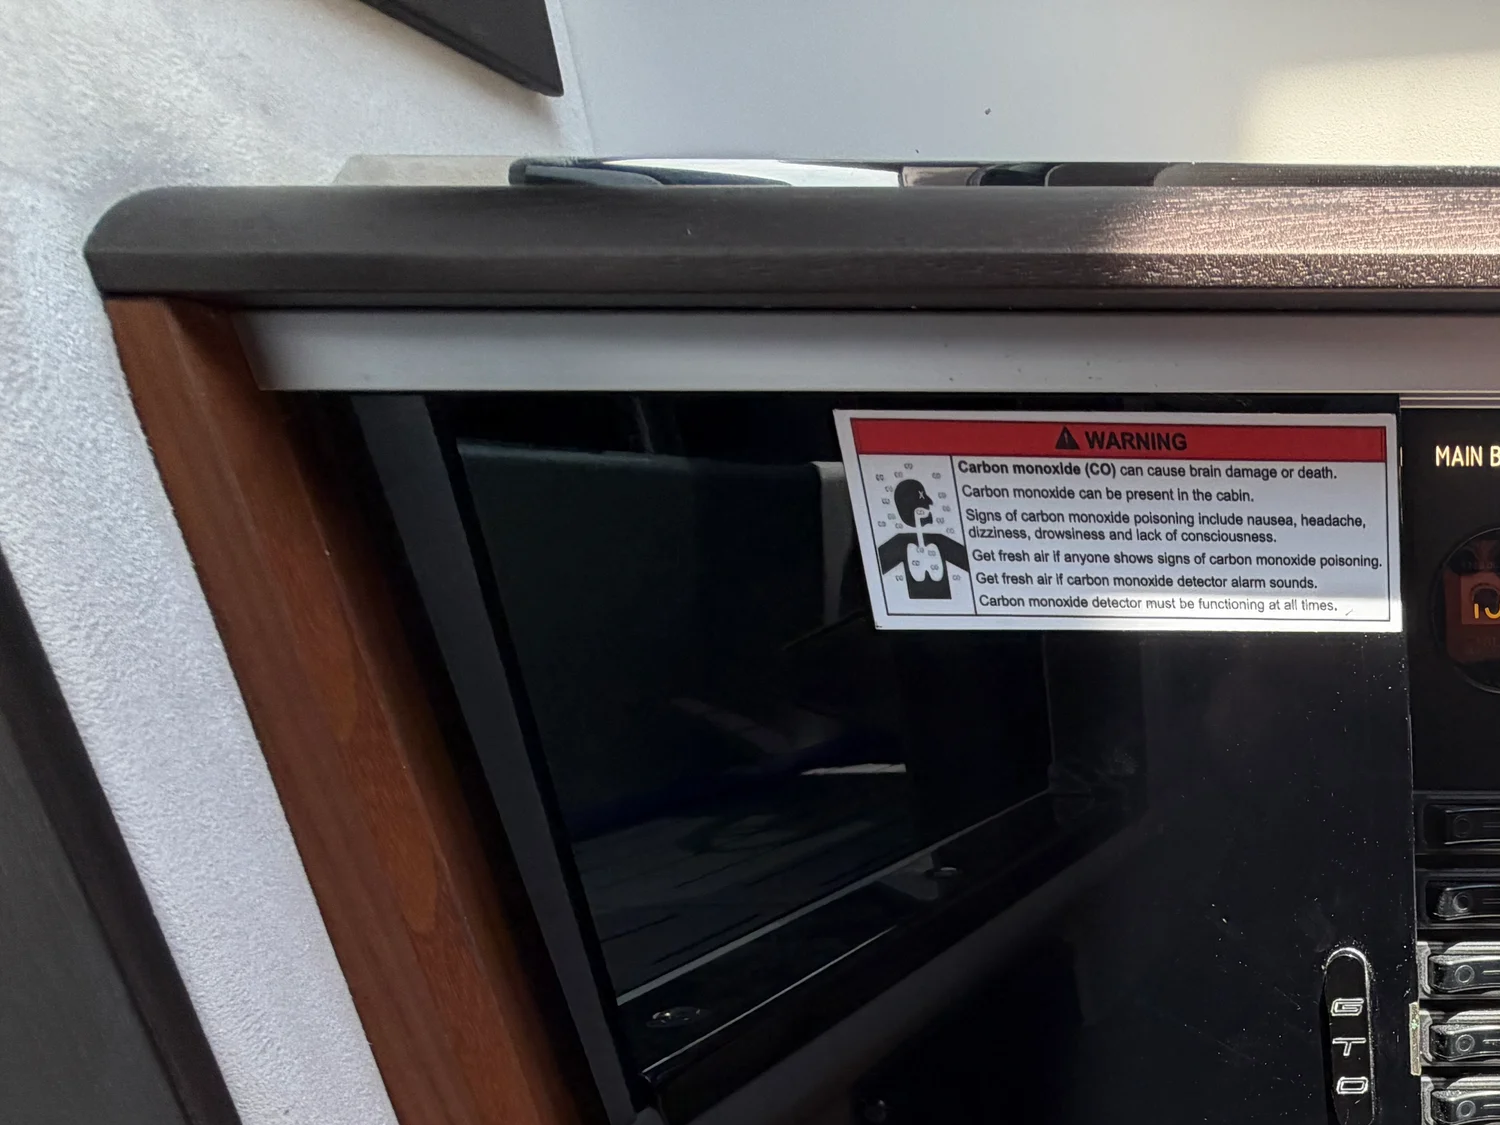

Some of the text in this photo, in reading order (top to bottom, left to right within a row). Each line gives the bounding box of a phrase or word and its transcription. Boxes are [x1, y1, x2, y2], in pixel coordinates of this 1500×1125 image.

[1085, 430, 1188, 451] WARNING
[1435, 445, 1483, 467] MAIN
[957, 460, 1337, 481] Carbon monoxide (CO) can cause brain damage or death.
[962, 485, 1254, 502] Carbon monoxide can be present in the cabin.
[966, 508, 1366, 528] Signs of carbon monoxide poisoning include nausea, headache,
[968, 526, 1277, 543] dizziness, drowsiness and lack of consciousness.
[972, 549, 1382, 570] Get fresh air if anyone shows signs of carbon monoxide poisoning.
[976, 572, 1318, 589] Get fresh air if carbon monoxide detector alarm sounds.
[979, 594, 1338, 613] Carbon monoxide detector must be functioning at all times.
